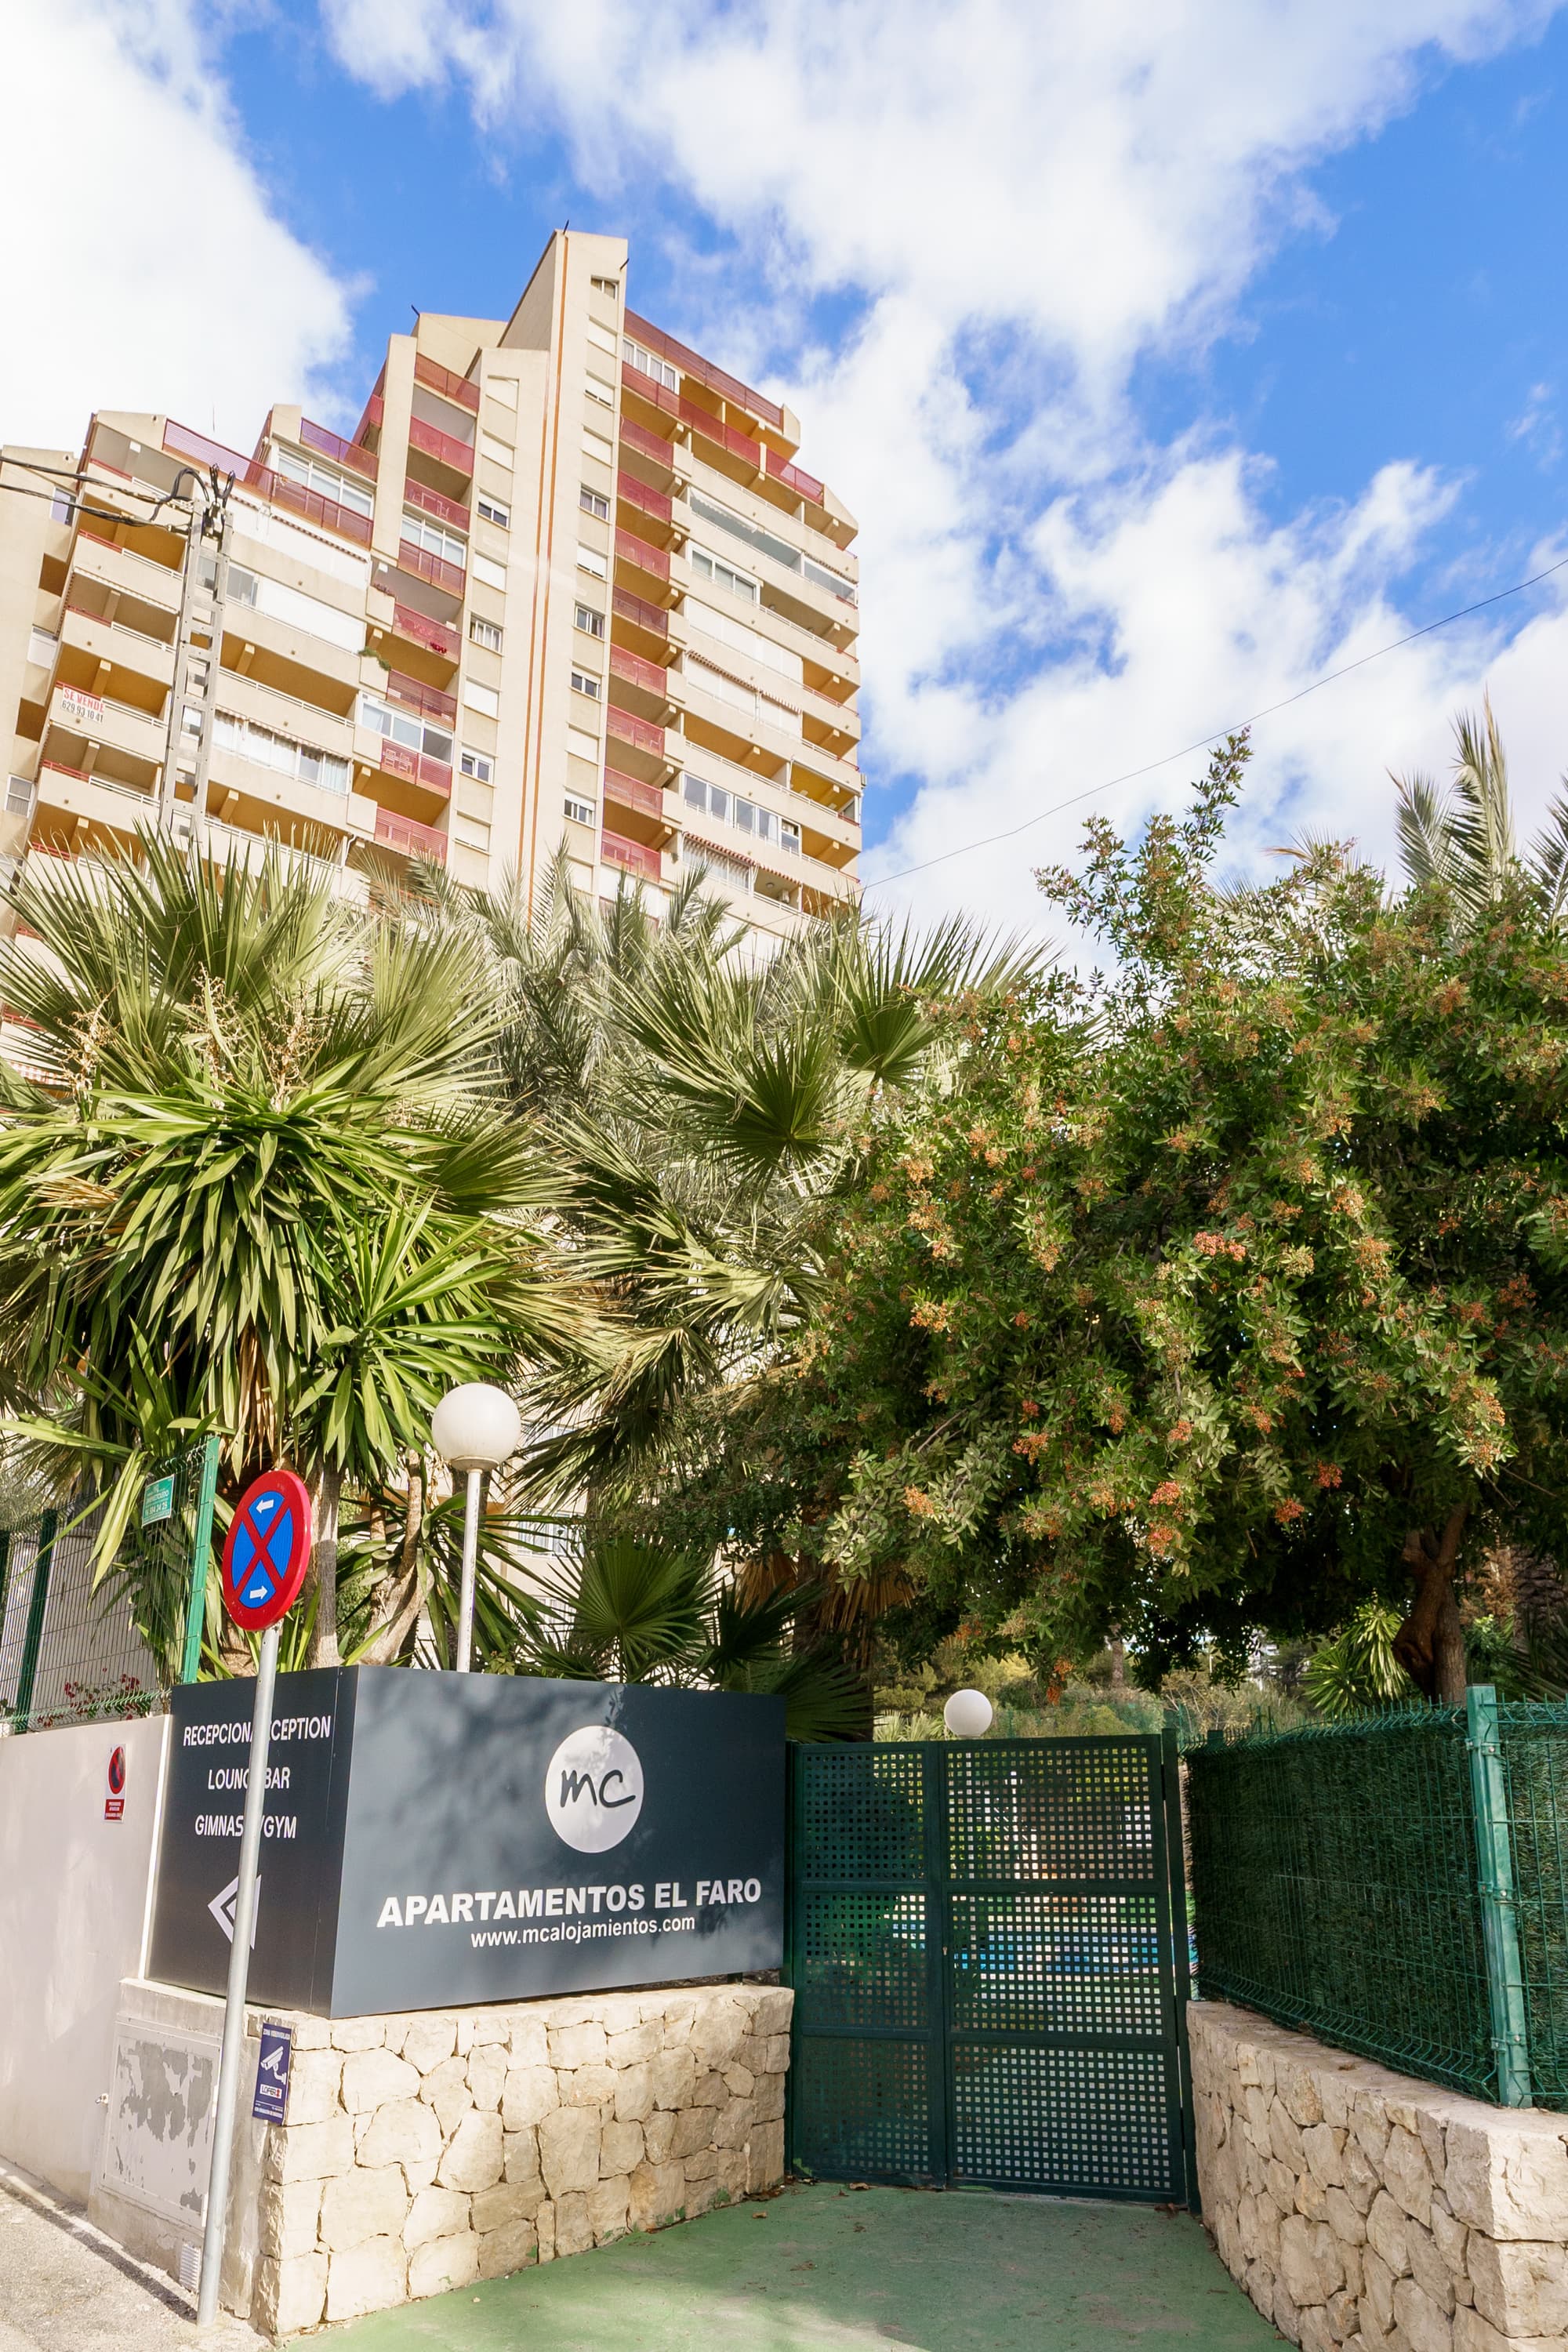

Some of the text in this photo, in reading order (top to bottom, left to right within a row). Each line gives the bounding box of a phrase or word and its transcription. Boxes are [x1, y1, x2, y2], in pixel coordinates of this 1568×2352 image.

[62, 699, 75, 712] 629
[64, 688, 105, 713] SE VENDE
[208, 1767, 291, 1790] LOUN BAR
[194, 1814, 297, 1838] GIMNAS/GYM
[377, 1878, 761, 1928] APARTAMENTOS EL FARO
[470, 1915, 696, 1948] www.mcalojamientos.com
